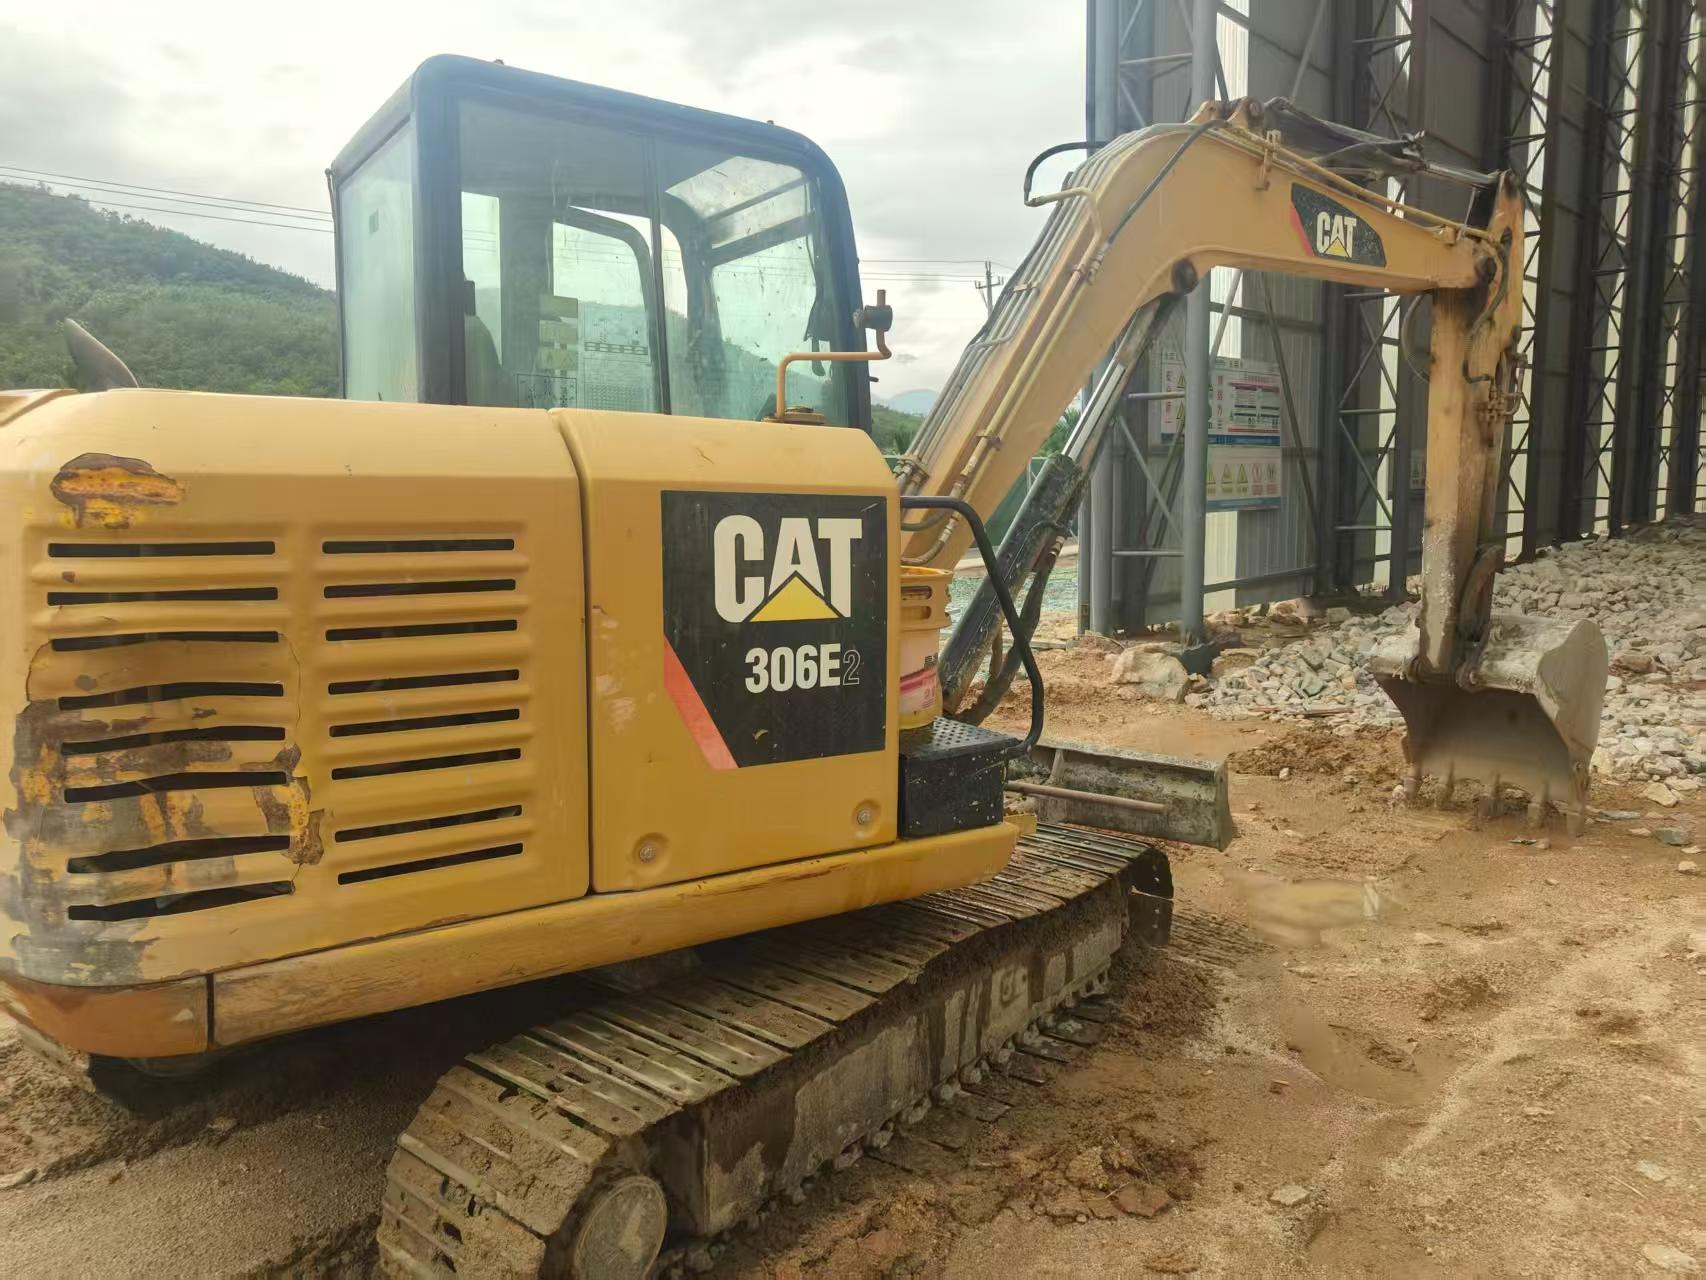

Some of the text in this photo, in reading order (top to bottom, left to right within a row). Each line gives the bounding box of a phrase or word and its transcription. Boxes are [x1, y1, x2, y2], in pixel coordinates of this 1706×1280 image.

[1316, 211, 1357, 258] CAT
[713, 514, 863, 623] CAT
[744, 643, 861, 694] 306E2
